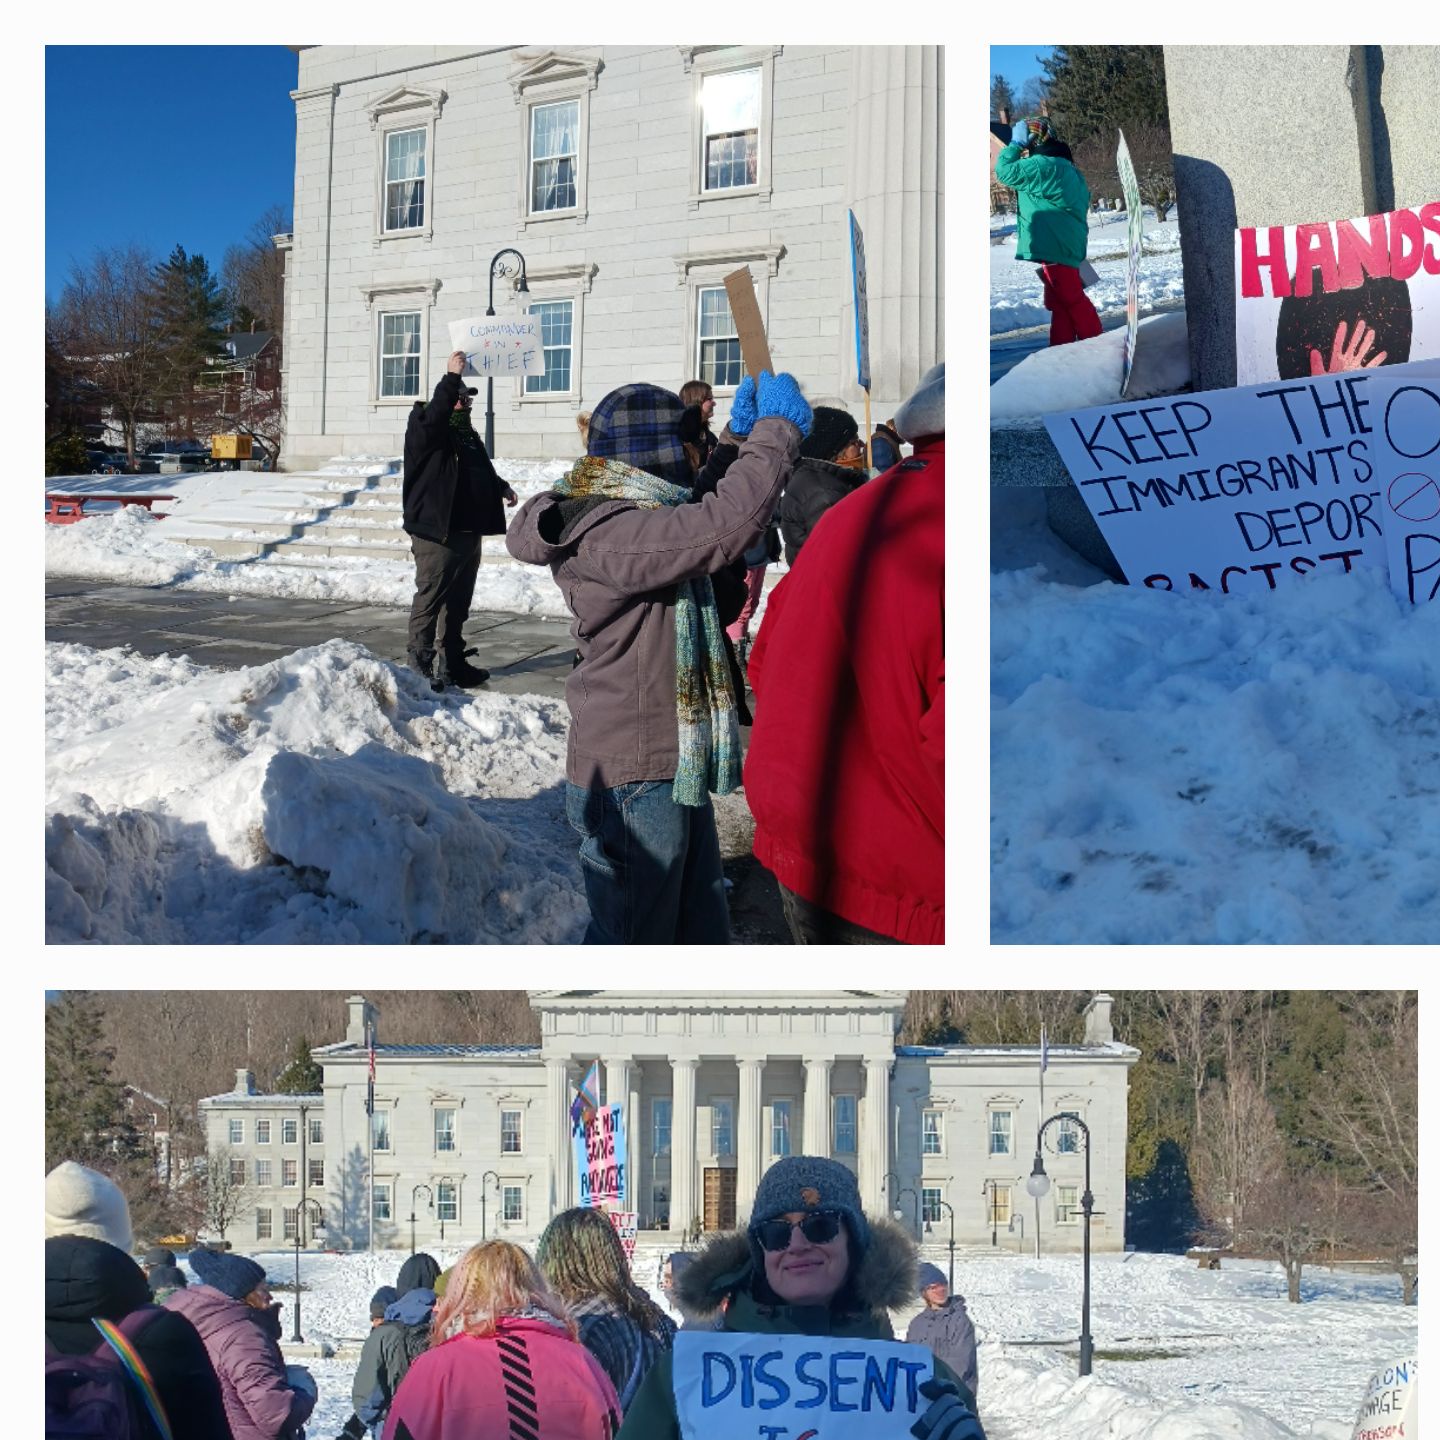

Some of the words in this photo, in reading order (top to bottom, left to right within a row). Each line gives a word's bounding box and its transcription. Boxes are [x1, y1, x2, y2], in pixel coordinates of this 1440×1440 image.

[465, 350, 536, 371] THIEF
[494, 340, 506, 348] IN
[1070, 401, 1212, 471] KEEP
[1256, 376, 1373, 445] THE
[1080, 439, 1373, 517] IMMIGRANTS
[1234, 491, 1383, 552] DEPOR
[701, 1350, 927, 1413] DISSENT
